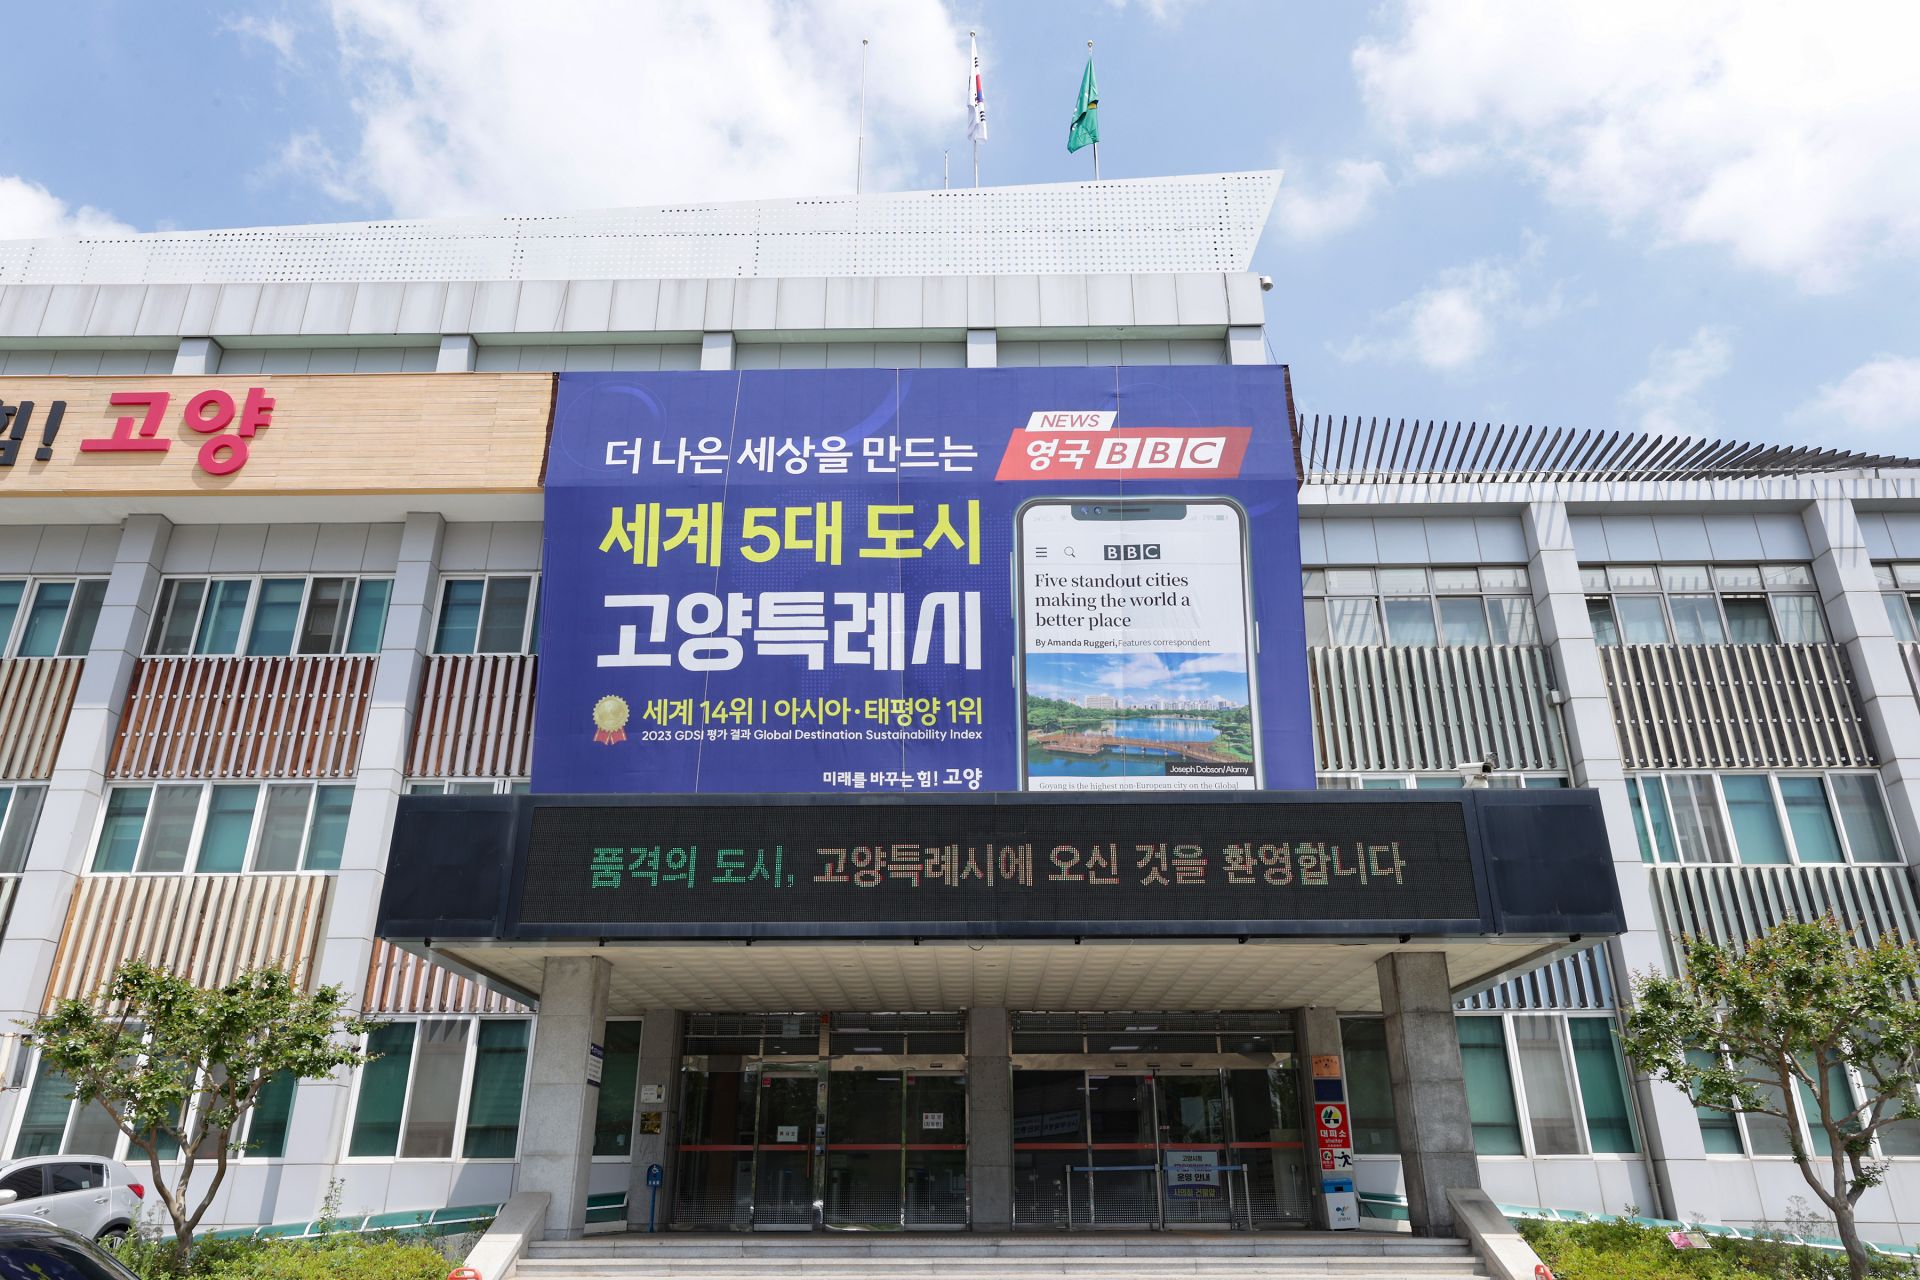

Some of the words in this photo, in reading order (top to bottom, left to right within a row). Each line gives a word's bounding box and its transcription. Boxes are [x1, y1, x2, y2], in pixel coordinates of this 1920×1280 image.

[1040, 413, 1101, 428] NEWS
[80, 387, 276, 477] 고양
[605, 437, 641, 474] 더
[652, 436, 729, 474] 나은
[737, 435, 853, 475] 세상을
[862, 435, 978, 473] 만드는
[1026, 438, 1091, 471] 영국
[1100, 439, 1221, 467] BBC
[598, 501, 723, 568] 세계
[739, 500, 843, 566] 5대
[859, 499, 981, 565] 도시
[1105, 545, 1160, 560] BBC
[1034, 573, 1068, 588] Five
[1071, 572, 1143, 588] standout
[1145, 572, 1189, 587] cities
[1035, 592, 1097, 611] making
[1100, 592, 1126, 608] the
[1129, 592, 1178, 607] world
[1180, 596, 1191, 607] a
[1035, 612, 1085, 628] better
[1088, 612, 1132, 631] place
[597, 591, 982, 672] 고양특례시
[1035, 638, 1046, 649] By
[1047, 638, 1082, 647] Amanda
[1083, 638, 1118, 649] Ruggeri,
[1118, 638, 1152, 648] Features
[1152, 638, 1211, 649] correspondent
[642, 698, 694, 726] 세계
[699, 697, 753, 726] 14위
[946, 696, 983, 725] 1위
[641, 730, 672, 741] 2023
[674, 730, 704, 741] GDSI
[706, 728, 728, 742] 평가
[730, 728, 751, 741] 결과
[753, 729, 792, 741] Global
[794, 729, 863, 741] Destination
[865, 729, 947, 742] Sustainability
[950, 729, 983, 740] Index
[823, 771, 868, 789] 미래를
[870, 770, 915, 788] 바꾸는
[916, 770, 938, 788] 힘!
[942, 767, 983, 791] 고양
[1169, 765, 1195, 775] Joseph
[590, 844, 697, 889] 품격의
[711, 844, 795, 888] 도시,
[813, 843, 1033, 888] 고양특례시에
[1048, 842, 1120, 886] 오신
[1135, 842, 1209, 886] 것을
[1222, 841, 1407, 886] 환영합니다
[1319, 1129, 1347, 1138] 대피소
